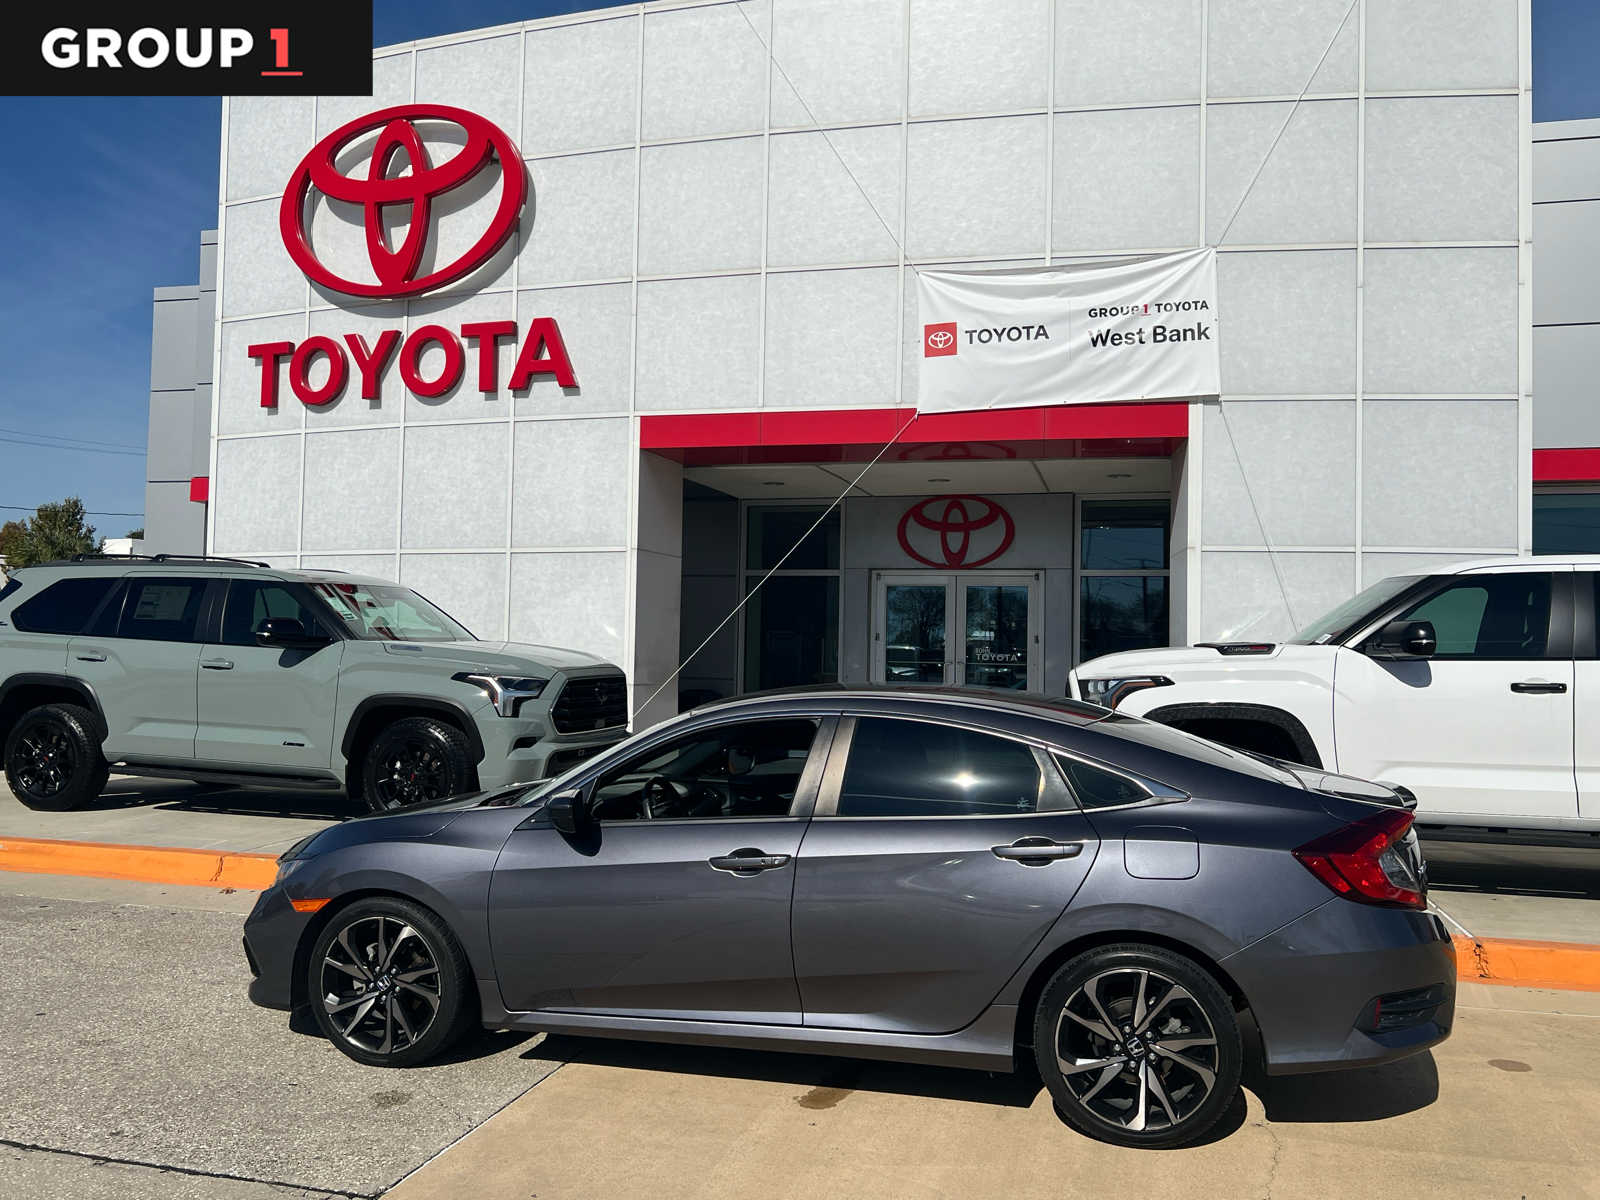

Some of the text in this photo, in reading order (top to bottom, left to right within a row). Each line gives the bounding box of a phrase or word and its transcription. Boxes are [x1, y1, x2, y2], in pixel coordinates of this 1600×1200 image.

[1088, 304, 1140, 318] GROUP
[1154, 300, 1209, 313] TOYOTA
[964, 324, 1050, 345] TOYOTA
[1088, 321, 1211, 348] West Bank
[248, 317, 577, 408] TOYOTA
[975, 653, 1018, 662] TOYOTA
